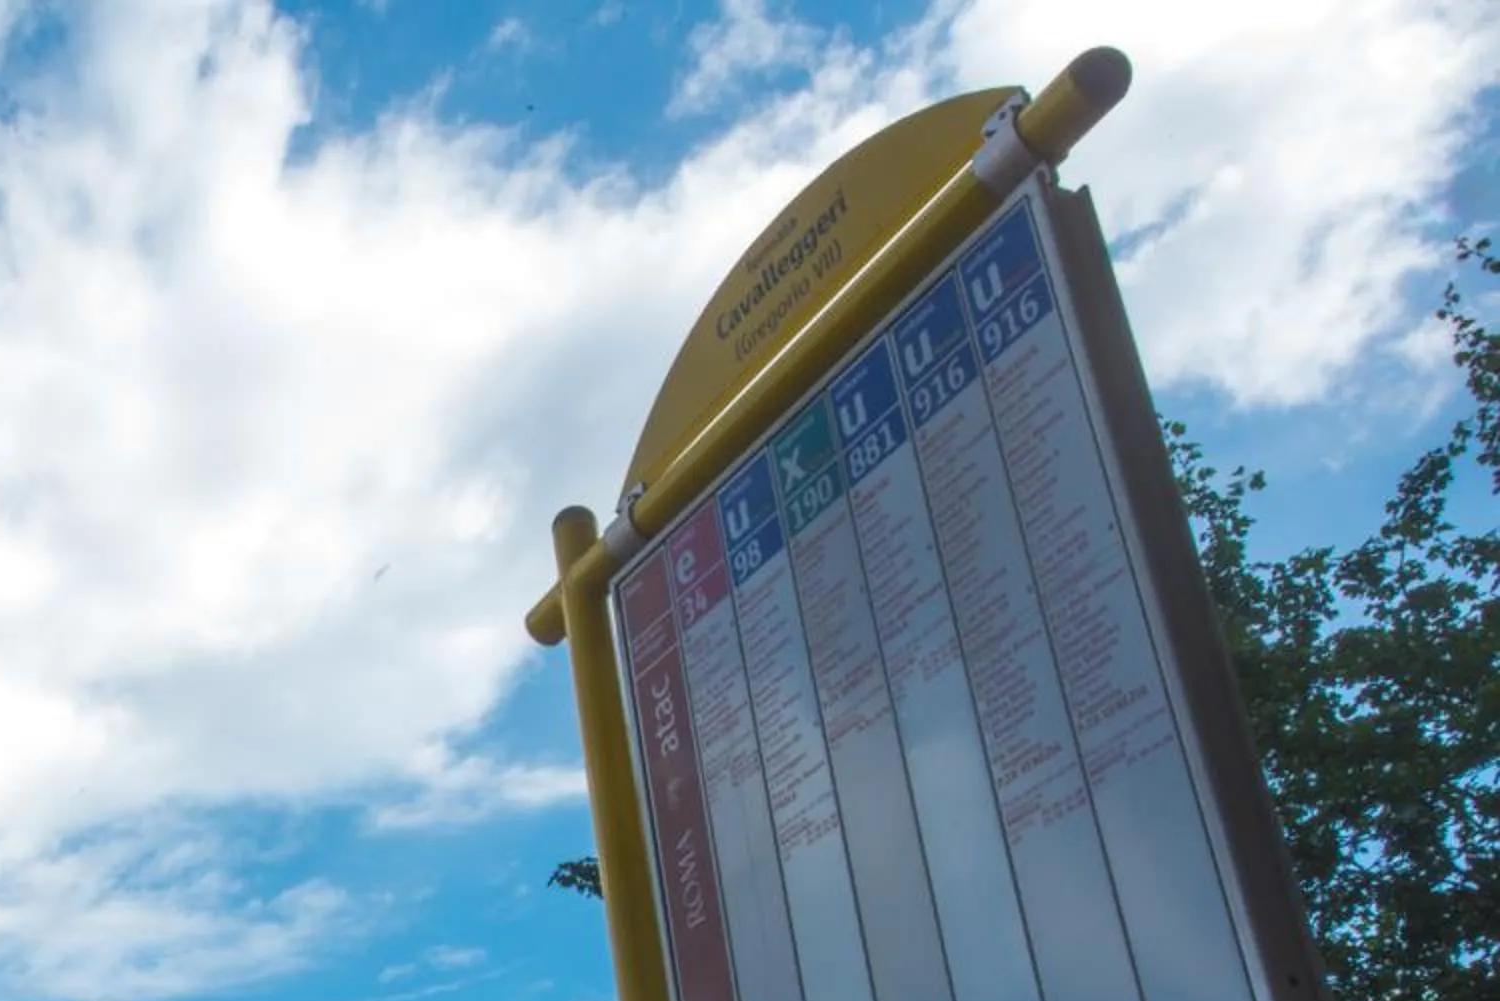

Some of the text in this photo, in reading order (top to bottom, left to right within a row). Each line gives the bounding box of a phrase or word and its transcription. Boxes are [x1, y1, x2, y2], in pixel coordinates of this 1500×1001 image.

[716, 187, 847, 340] Cavalleggeri
[735, 277, 810, 361] (Gregorio
[813, 238, 843, 279] VII)
[982, 289, 1040, 356] 916
[914, 357, 965, 420] 916
[850, 421, 896, 480] 881
[790, 476, 833, 529] 190
[735, 540, 762, 579] 98
[682, 592, 707, 626] 34
[651, 674, 679, 757] atac
[676, 828, 706, 928] ROMA
